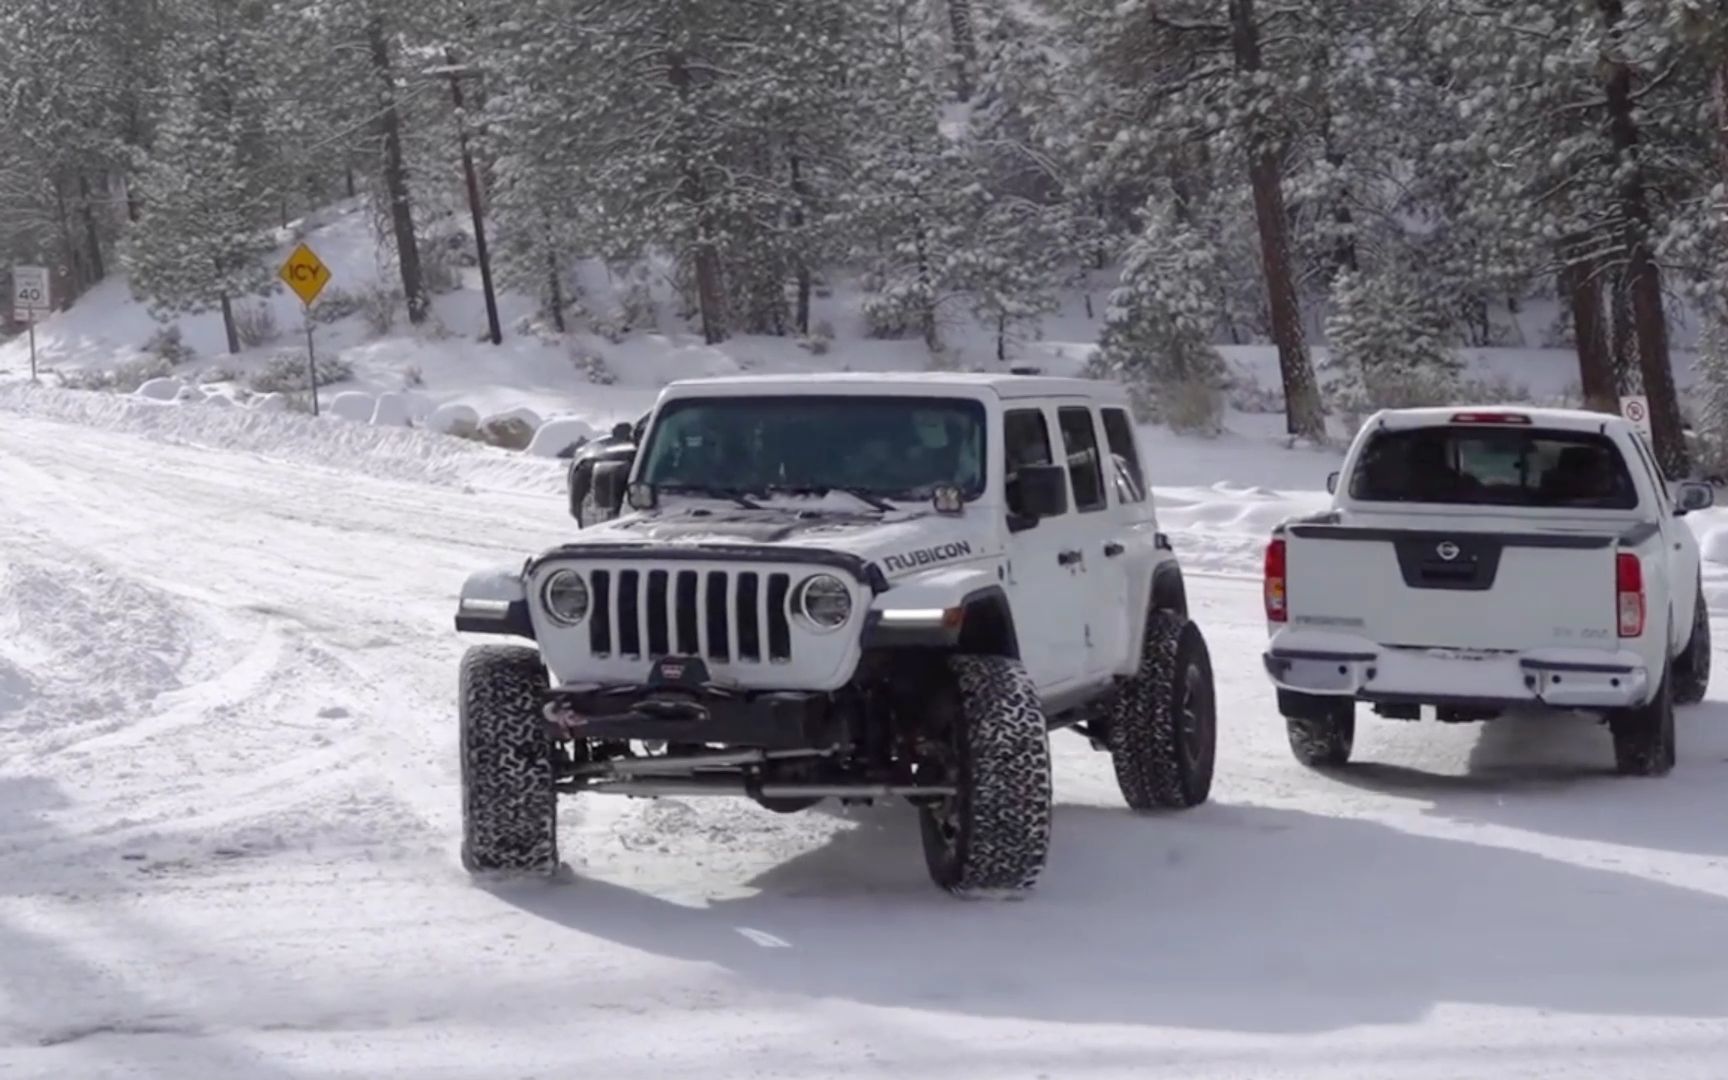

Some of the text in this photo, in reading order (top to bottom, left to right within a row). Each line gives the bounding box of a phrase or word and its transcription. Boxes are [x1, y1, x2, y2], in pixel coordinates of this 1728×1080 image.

[288, 263, 320, 281] ICY
[19, 288, 40, 301] 40
[883, 540, 971, 572] RUBICON
